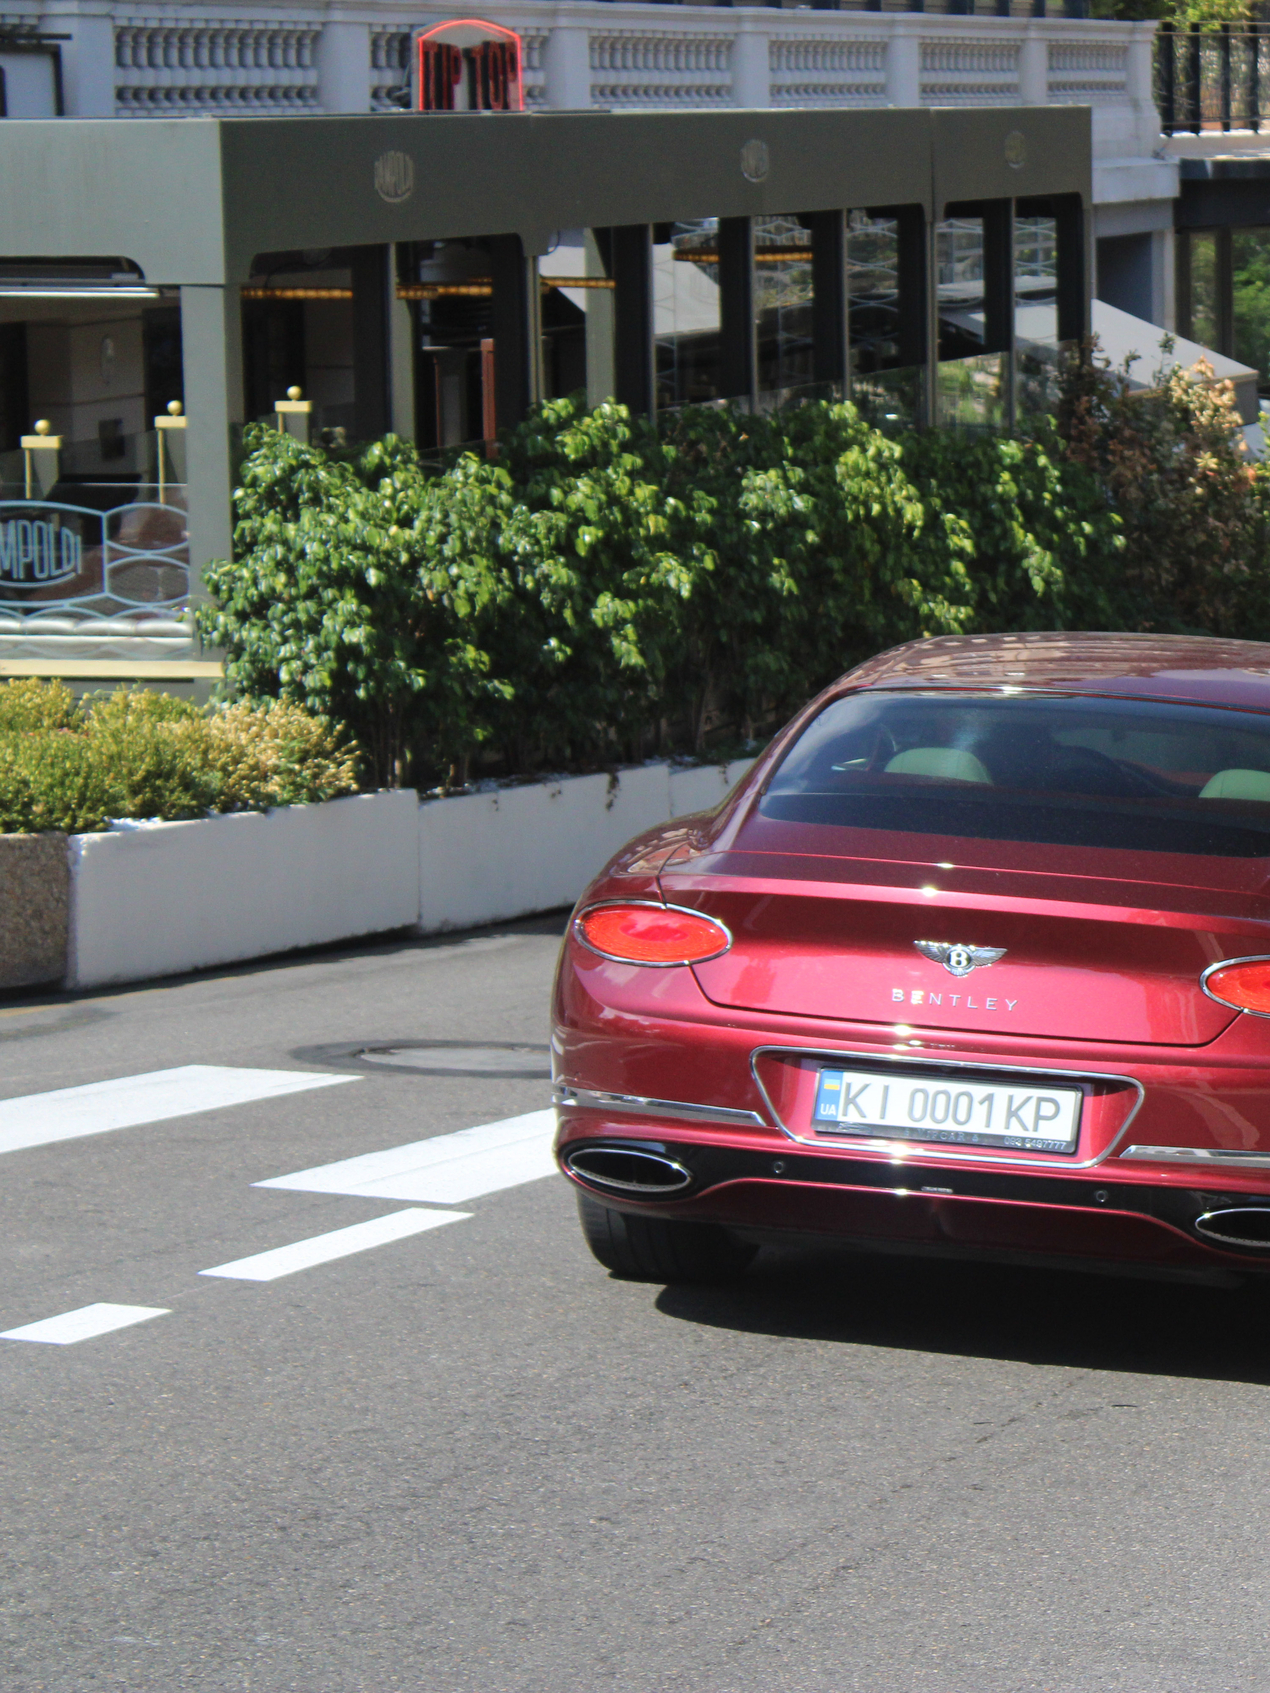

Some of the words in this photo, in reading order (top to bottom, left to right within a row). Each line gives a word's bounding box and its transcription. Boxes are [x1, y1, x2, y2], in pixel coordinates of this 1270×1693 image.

[423, 40, 461, 110] TIP
[470, 39, 517, 110] TOP
[949, 950, 969, 968] B
[892, 988, 1018, 1011] BENTLEY
[820, 1103, 836, 1116] UA
